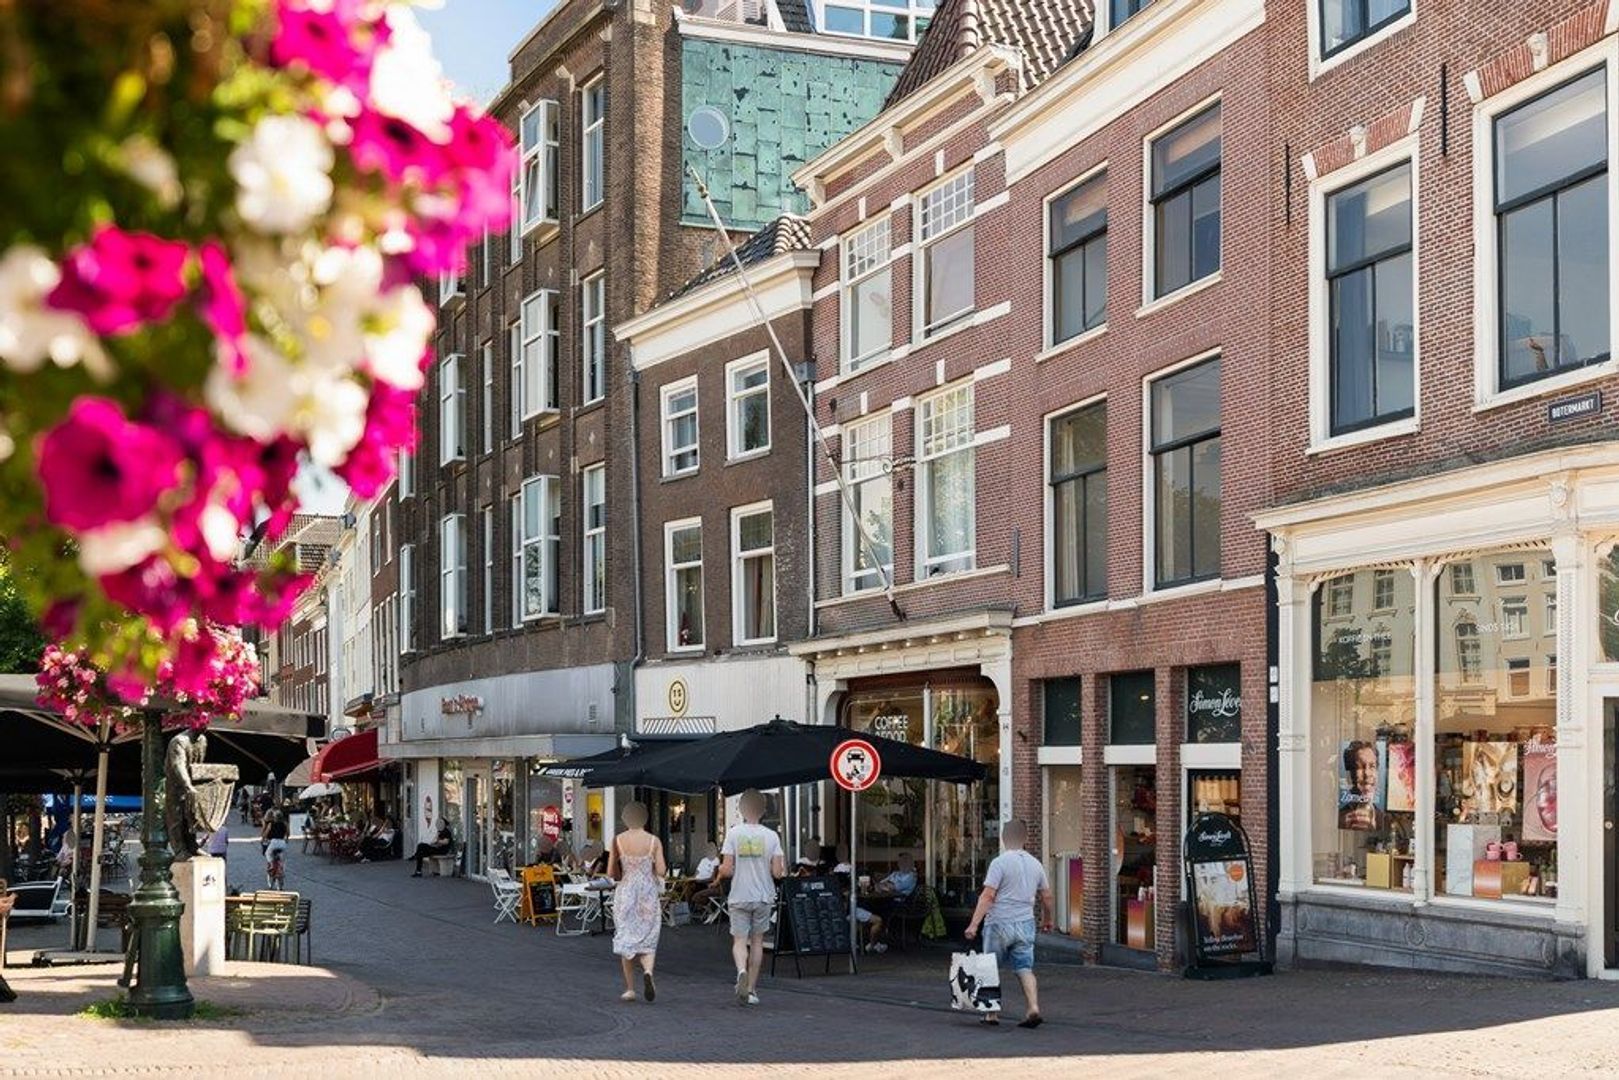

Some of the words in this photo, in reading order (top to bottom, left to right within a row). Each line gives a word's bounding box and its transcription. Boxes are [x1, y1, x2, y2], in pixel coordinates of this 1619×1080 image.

[1551, 398, 1595, 418] BOTERMARKT
[1190, 690, 1221, 713] Simon
[874, 715, 909, 730] COFFEE
